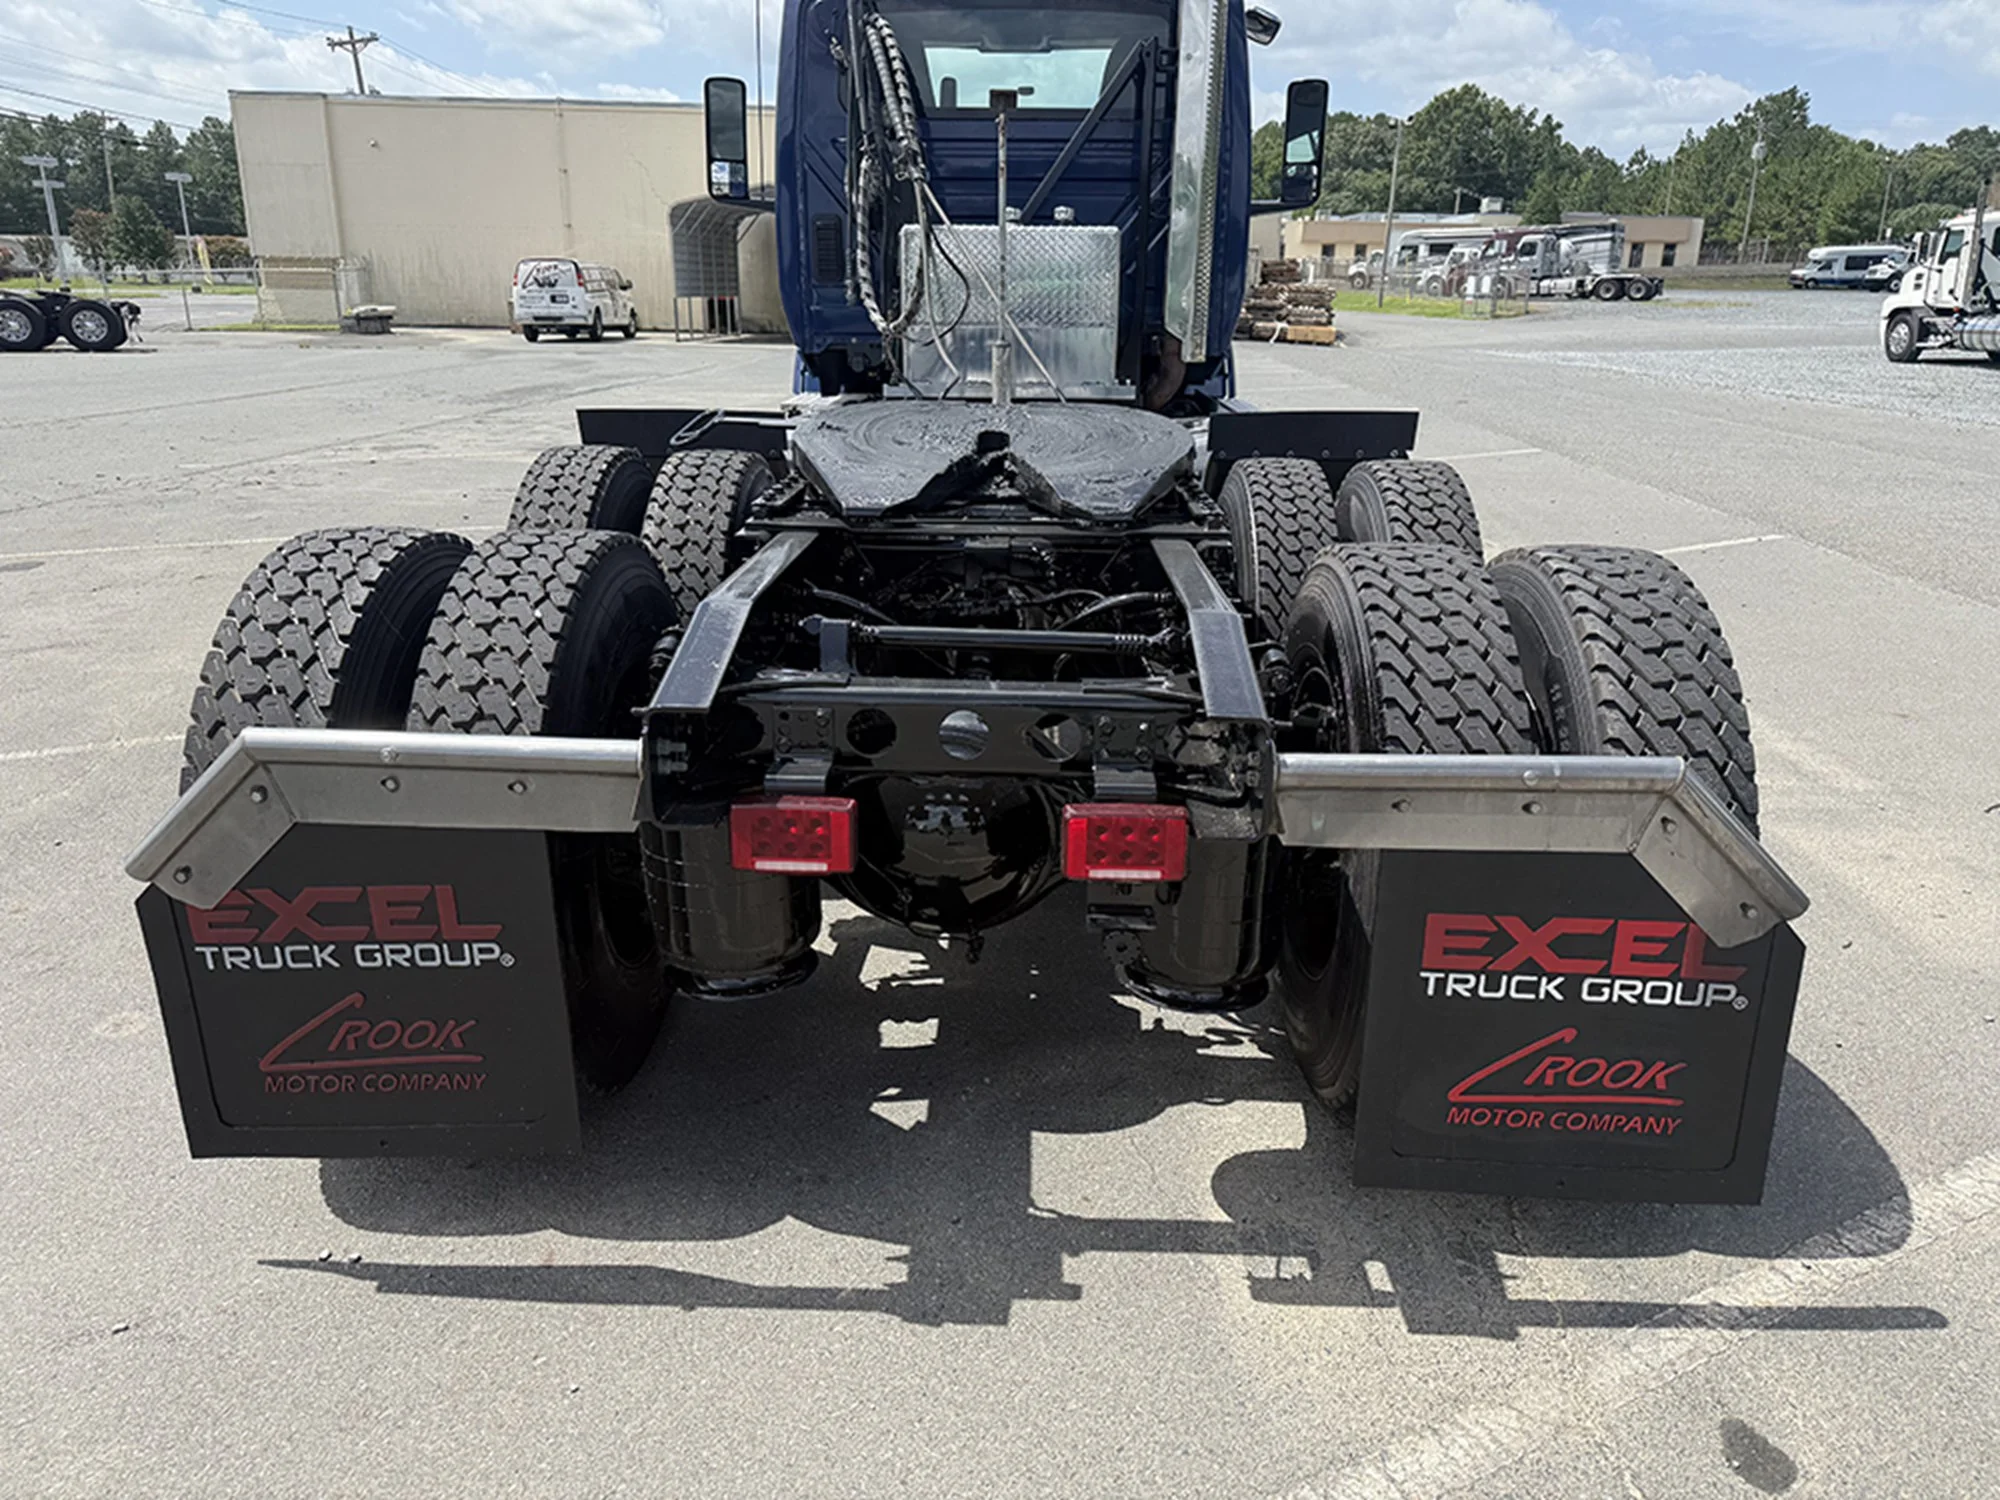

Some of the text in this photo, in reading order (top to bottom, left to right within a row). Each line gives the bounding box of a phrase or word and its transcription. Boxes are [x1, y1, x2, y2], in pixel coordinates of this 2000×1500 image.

[186, 885, 502, 943] EXCEL
[195, 945, 340, 970] TRUCK
[1421, 913, 1748, 981] EXCEL
[1419, 971, 1565, 1001] TRUCK
[264, 1073, 487, 1092] MOTOR COMPANY
[1447, 1107, 1682, 1135] MOTOR COMPANY
